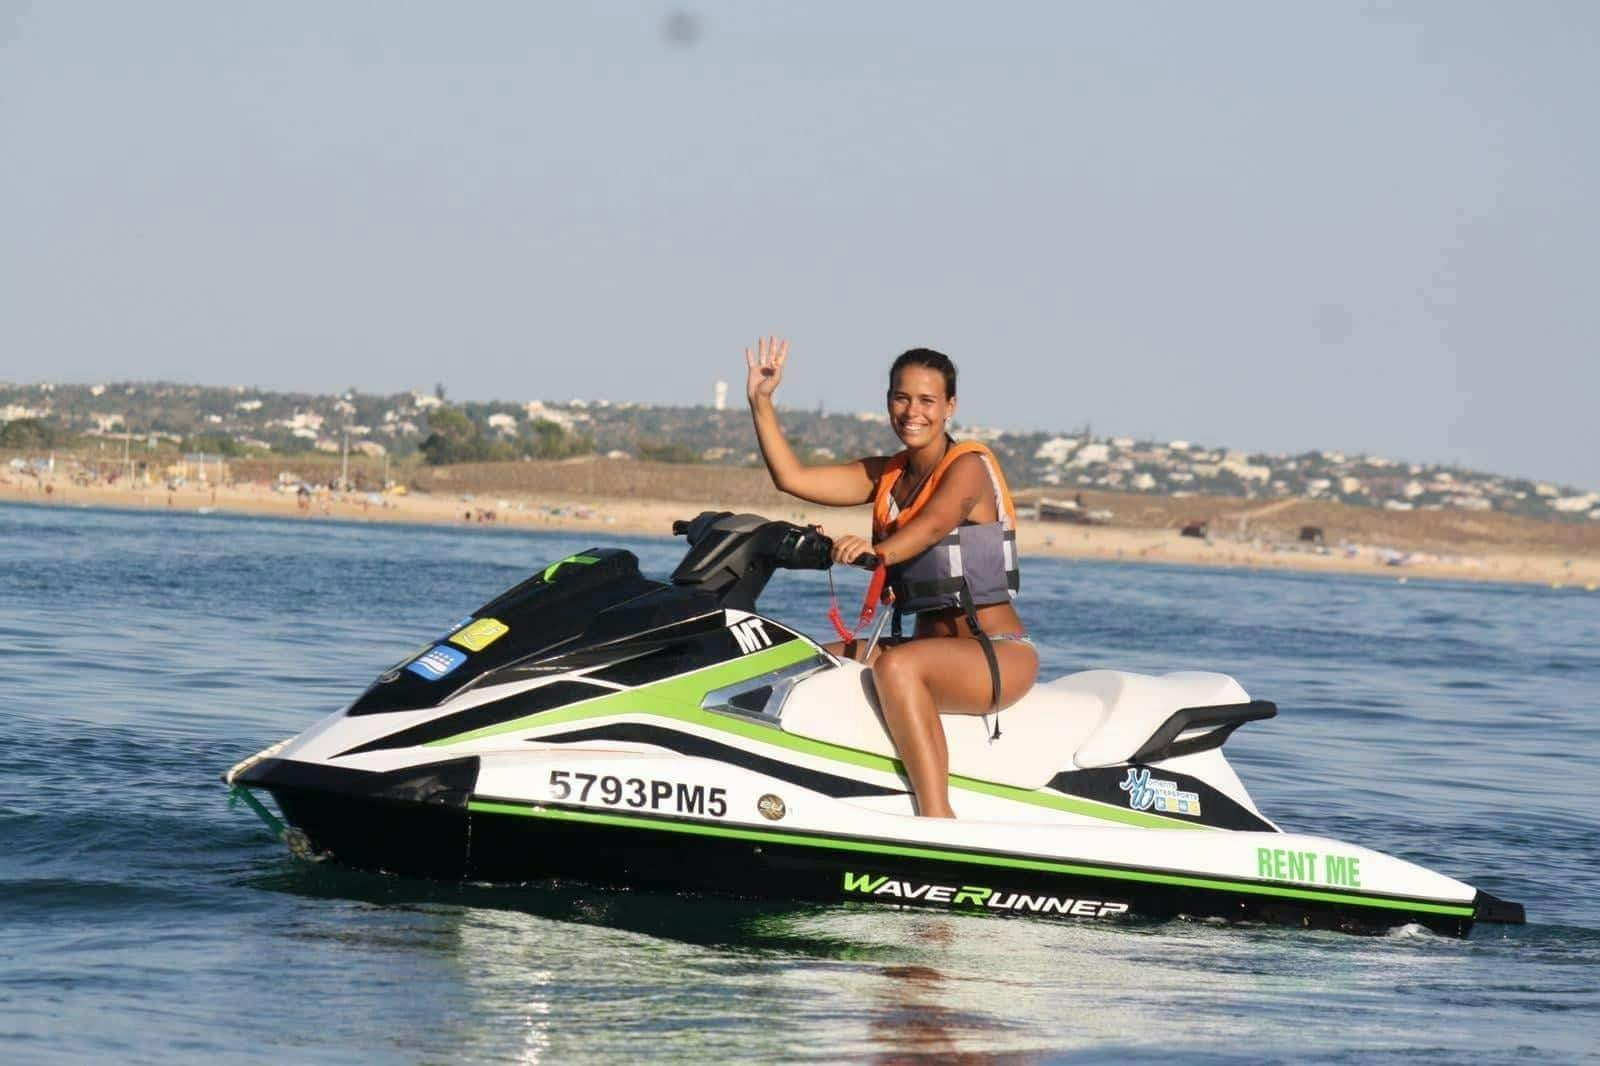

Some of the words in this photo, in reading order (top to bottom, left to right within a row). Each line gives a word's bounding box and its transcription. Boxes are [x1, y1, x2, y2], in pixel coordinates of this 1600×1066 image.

[729, 618, 773, 655] MT
[549, 770, 728, 818] 5793PM5
[1257, 848, 1317, 882] RENT
[1326, 855, 1360, 887] ME
